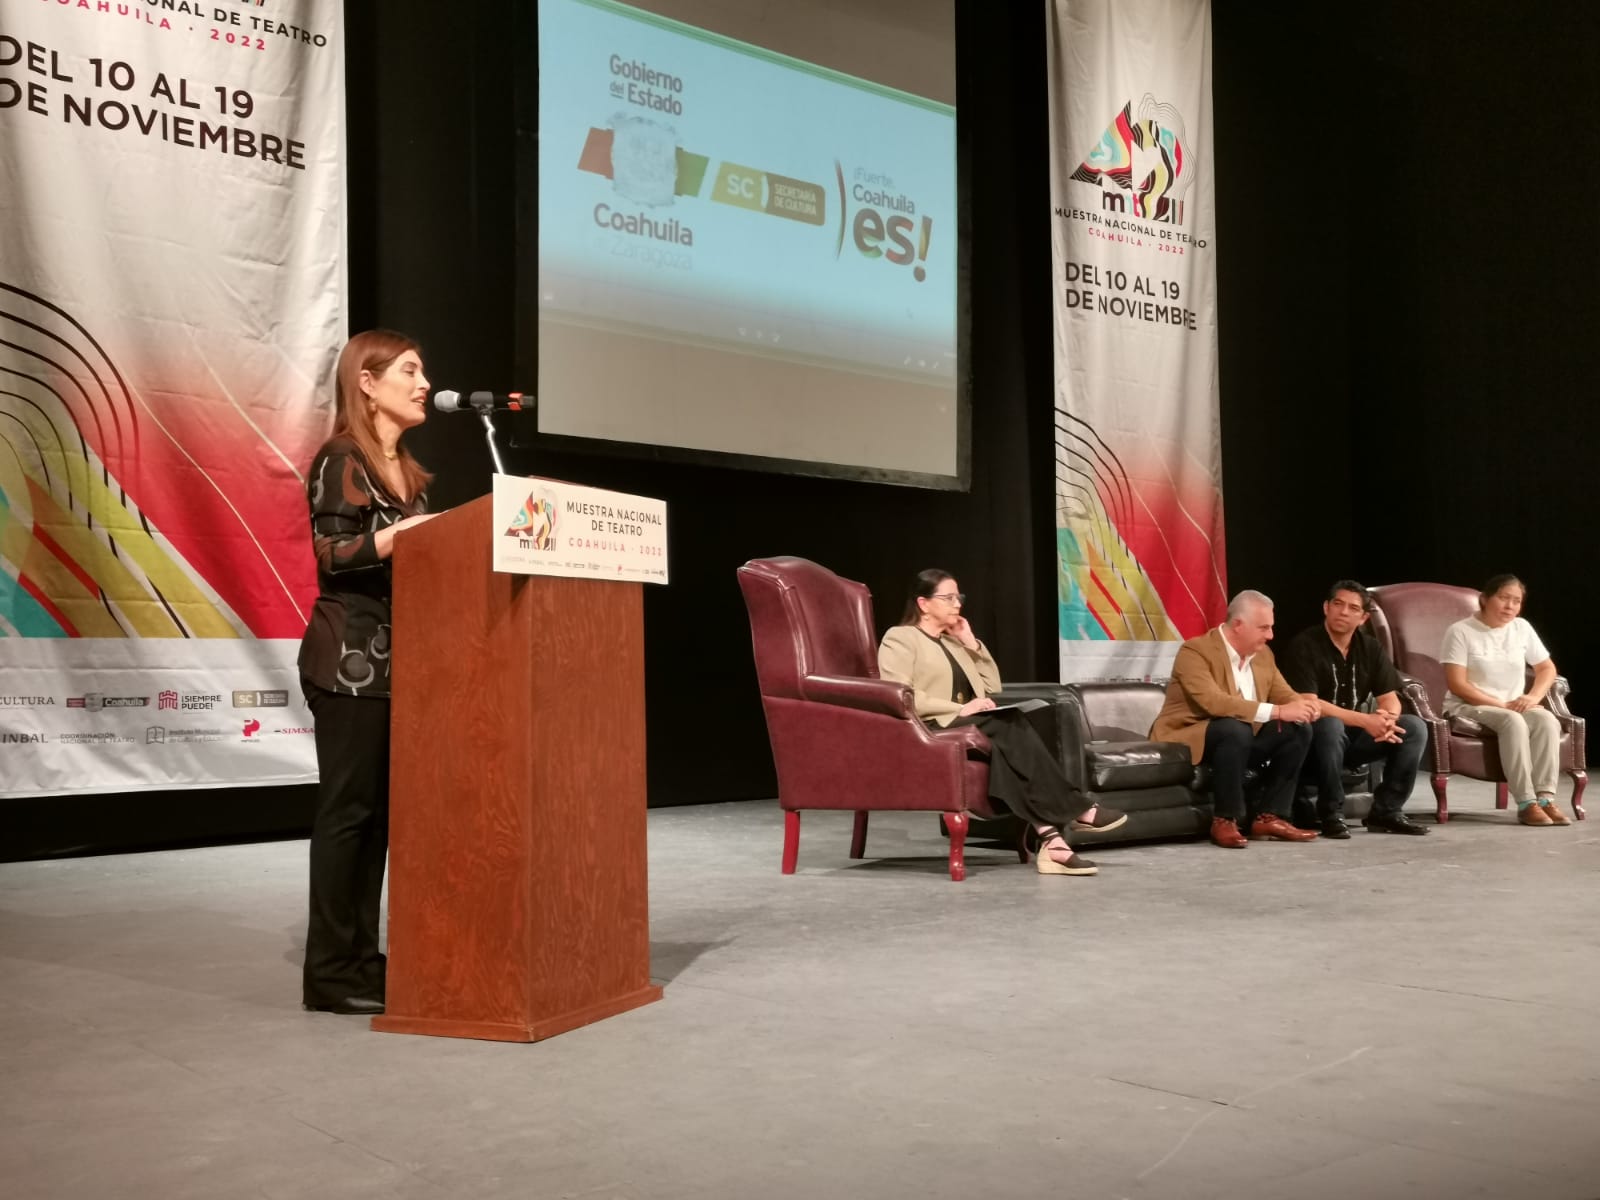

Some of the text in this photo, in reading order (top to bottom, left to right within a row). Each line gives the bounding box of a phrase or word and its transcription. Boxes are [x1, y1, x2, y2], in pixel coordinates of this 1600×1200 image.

[210, 28, 265, 50] 2022
[214, 8, 240, 26] DE
[250, 16, 327, 47] TEATRO
[0, 35, 254, 118] DEL 10 AL 19
[610, 54, 683, 93] Gobierno
[610, 80, 682, 116] del Estado
[0, 77, 305, 170] DE NOVIEMBRE
[727, 174, 754, 199] SC
[853, 184, 915, 215] Coahuila
[593, 203, 694, 247] Coahuila
[1055, 208, 1102, 224] MUESTRA
[1105, 219, 1156, 238] NACIONAL
[1160, 230, 1173, 240] DE
[853, 208, 933, 282] es!
[1088, 227, 1185, 255] COAHUILA 2022
[1066, 261, 1180, 300] DEL 10 AL 19
[1066, 288, 1197, 331] DE NOVIEMBRE
[567, 501, 662, 526] MUESTRA NACIONAL
[591, 519, 643, 537] DE TEATRO
[569, 537, 626, 552] COAHUILA
[181, 702, 214, 710] PUEDE!
[239, 694, 254, 704] SC
[2, 733, 49, 744] INBAL
